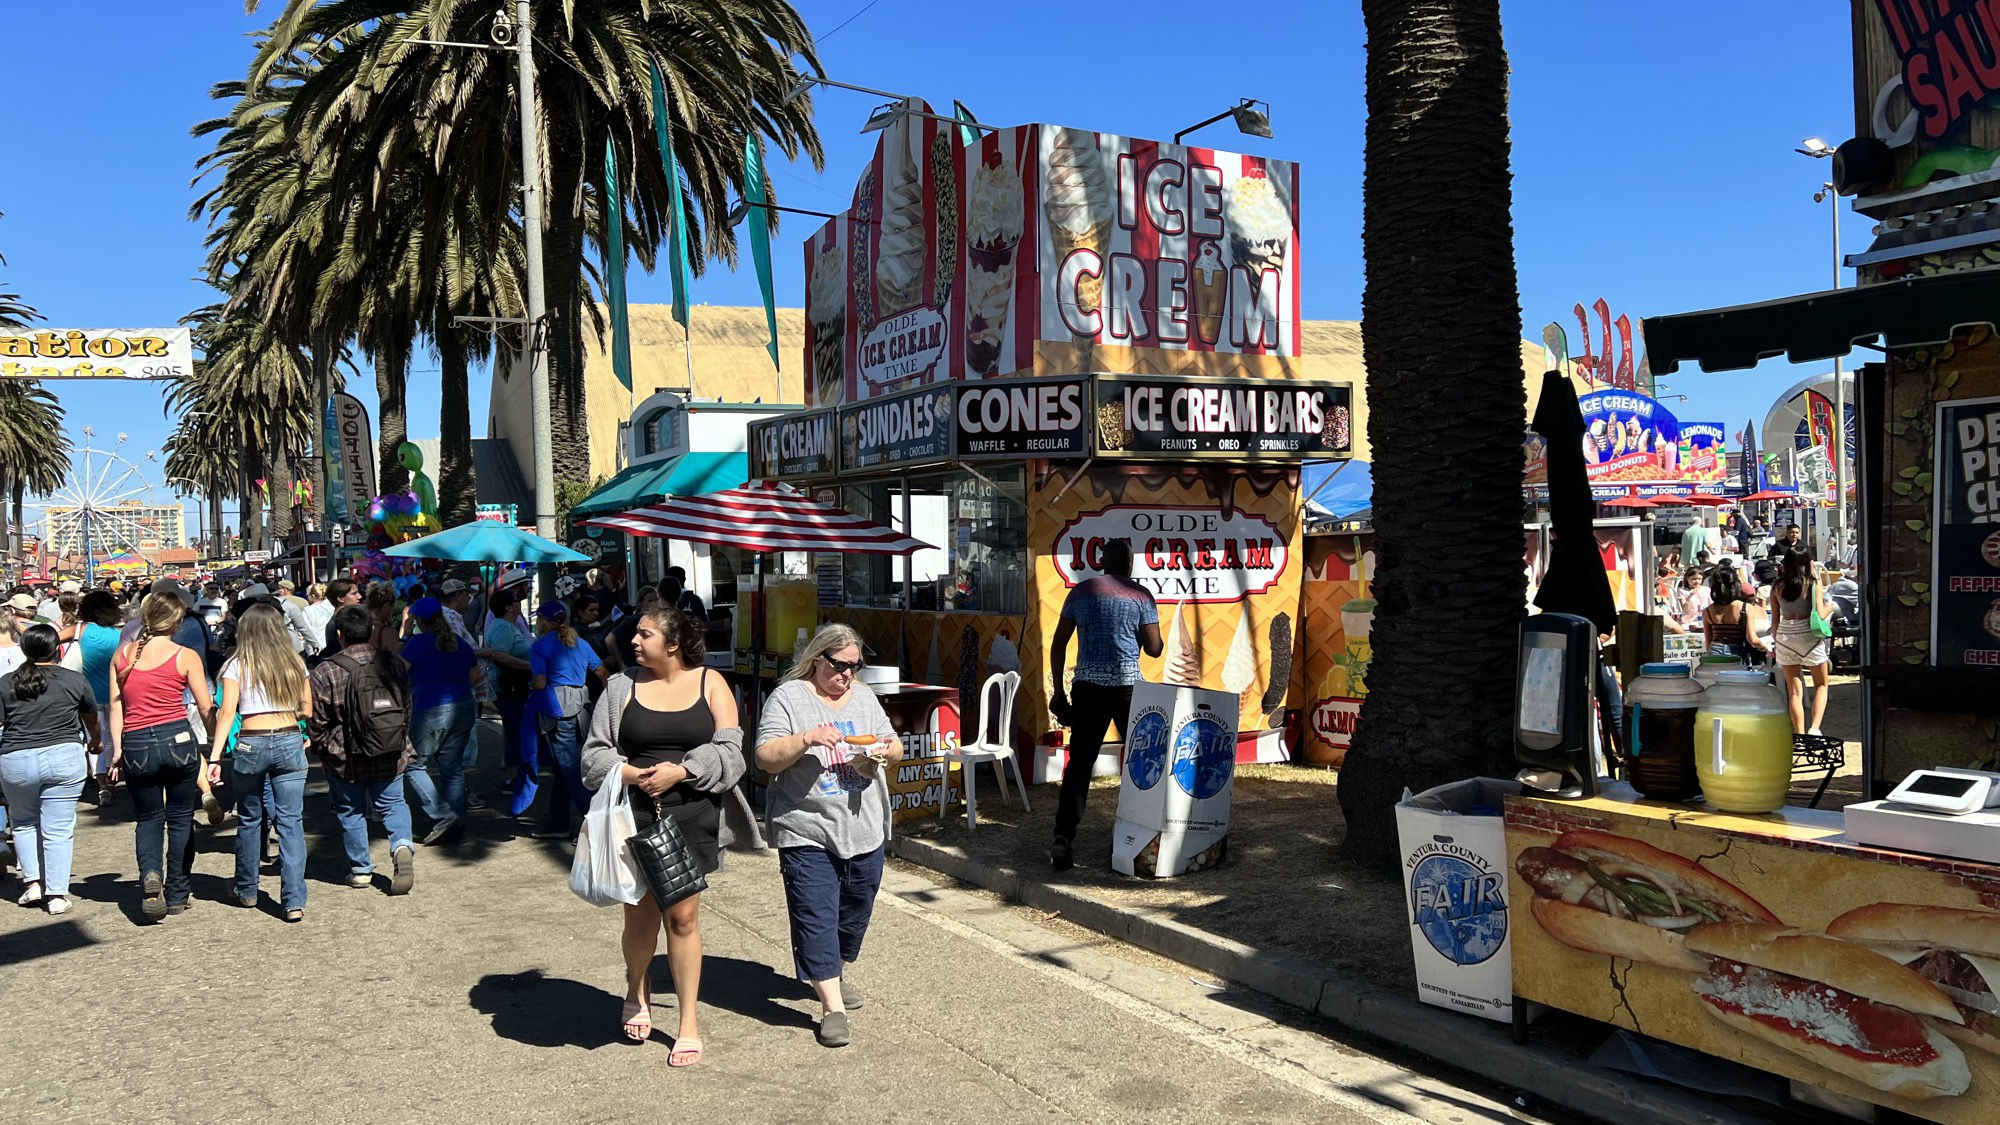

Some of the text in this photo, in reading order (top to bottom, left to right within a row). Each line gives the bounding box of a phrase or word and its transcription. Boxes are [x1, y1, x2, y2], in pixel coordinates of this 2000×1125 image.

[1908, 0, 2000, 137] SAU
[1117, 153, 1225, 240] ICE
[884, 315, 918, 335] OLDE
[864, 327, 942, 369] ICE CREAM
[884, 359, 918, 378] TYME
[958, 384, 1081, 433] CONES
[1124, 386, 1324, 434] ICE CREAM BARS
[1579, 396, 1652, 416] ICE CREAM
[857, 394, 934, 450] SUNDAES
[760, 418, 825, 462] ICE CREAM
[1680, 425, 1723, 440] LEMONADE
[909, 443, 934, 457] CHOCOLATE
[970, 438, 1070, 451] WAFFLE REGULAR
[1161, 438, 1299, 450] PEANUTS OREO SPRINKLES
[1587, 455, 1647, 476] MINI DONUTS
[1592, 488, 1624, 496] CREAM
[1641, 487, 1687, 495] MINI DONUTS
[1131, 513, 1219, 532] OLDE
[328, 529, 341, 539] 15
[1144, 537, 1274, 571] CREAM
[1131, 576, 1220, 595] TYME
[1132, 705, 1155, 724] VENTURA
[1175, 712, 1230, 733] VENTURA COUNTY
[900, 730, 957, 760] EFILLS
[1126, 726, 1170, 764] FAIR
[1170, 732, 1235, 776] FAIR
[897, 764, 922, 784] ANY
[890, 793, 903, 811] UP
[905, 791, 922, 809] TO
[923, 784, 942, 806] 44
[1406, 843, 1491, 870] VENTURA COUNTY
[1413, 872, 1509, 925] FAIR
[1421, 982, 1449, 995] COURTESY
[1451, 998, 1485, 1010] CAMARILLO
